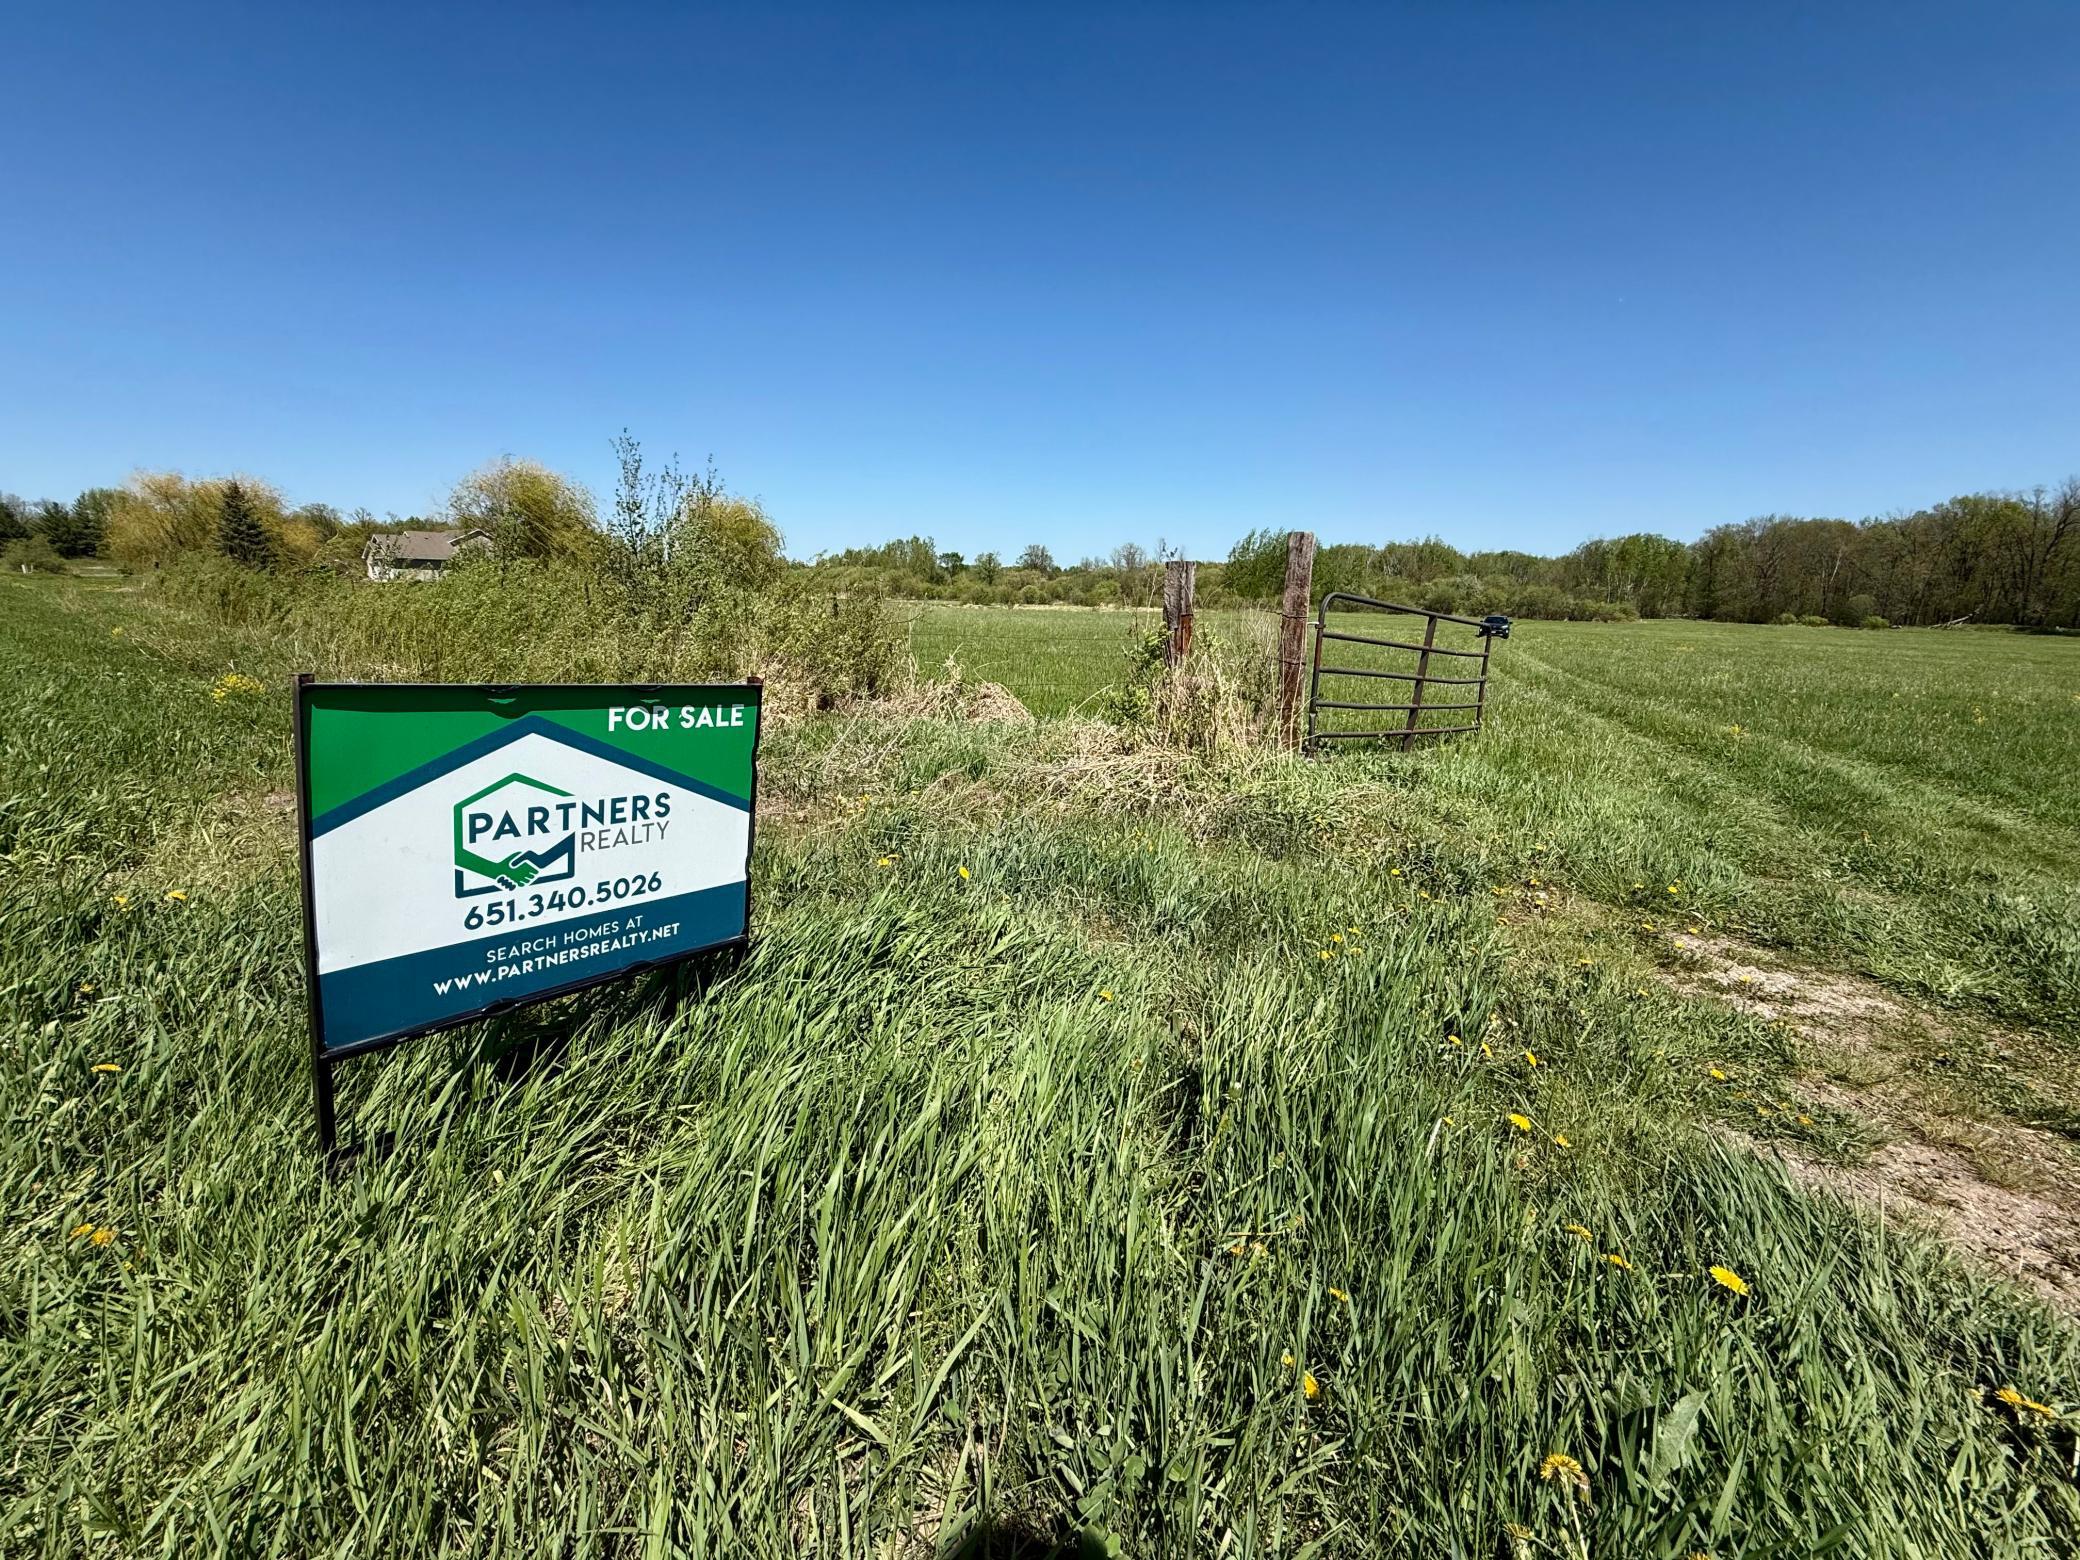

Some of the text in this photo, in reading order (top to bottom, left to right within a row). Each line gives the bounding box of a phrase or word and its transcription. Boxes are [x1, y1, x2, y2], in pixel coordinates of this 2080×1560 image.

[608, 703, 744, 732] FOR SALE
[468, 792, 672, 844] PARTNERS
[580, 820, 670, 853] REALTY
[463, 871, 662, 931] 651.340.5026
[433, 922, 680, 995] WWW.PARTNERSREALTY.NET
[486, 915, 644, 964] SEARCH HOMES AT
